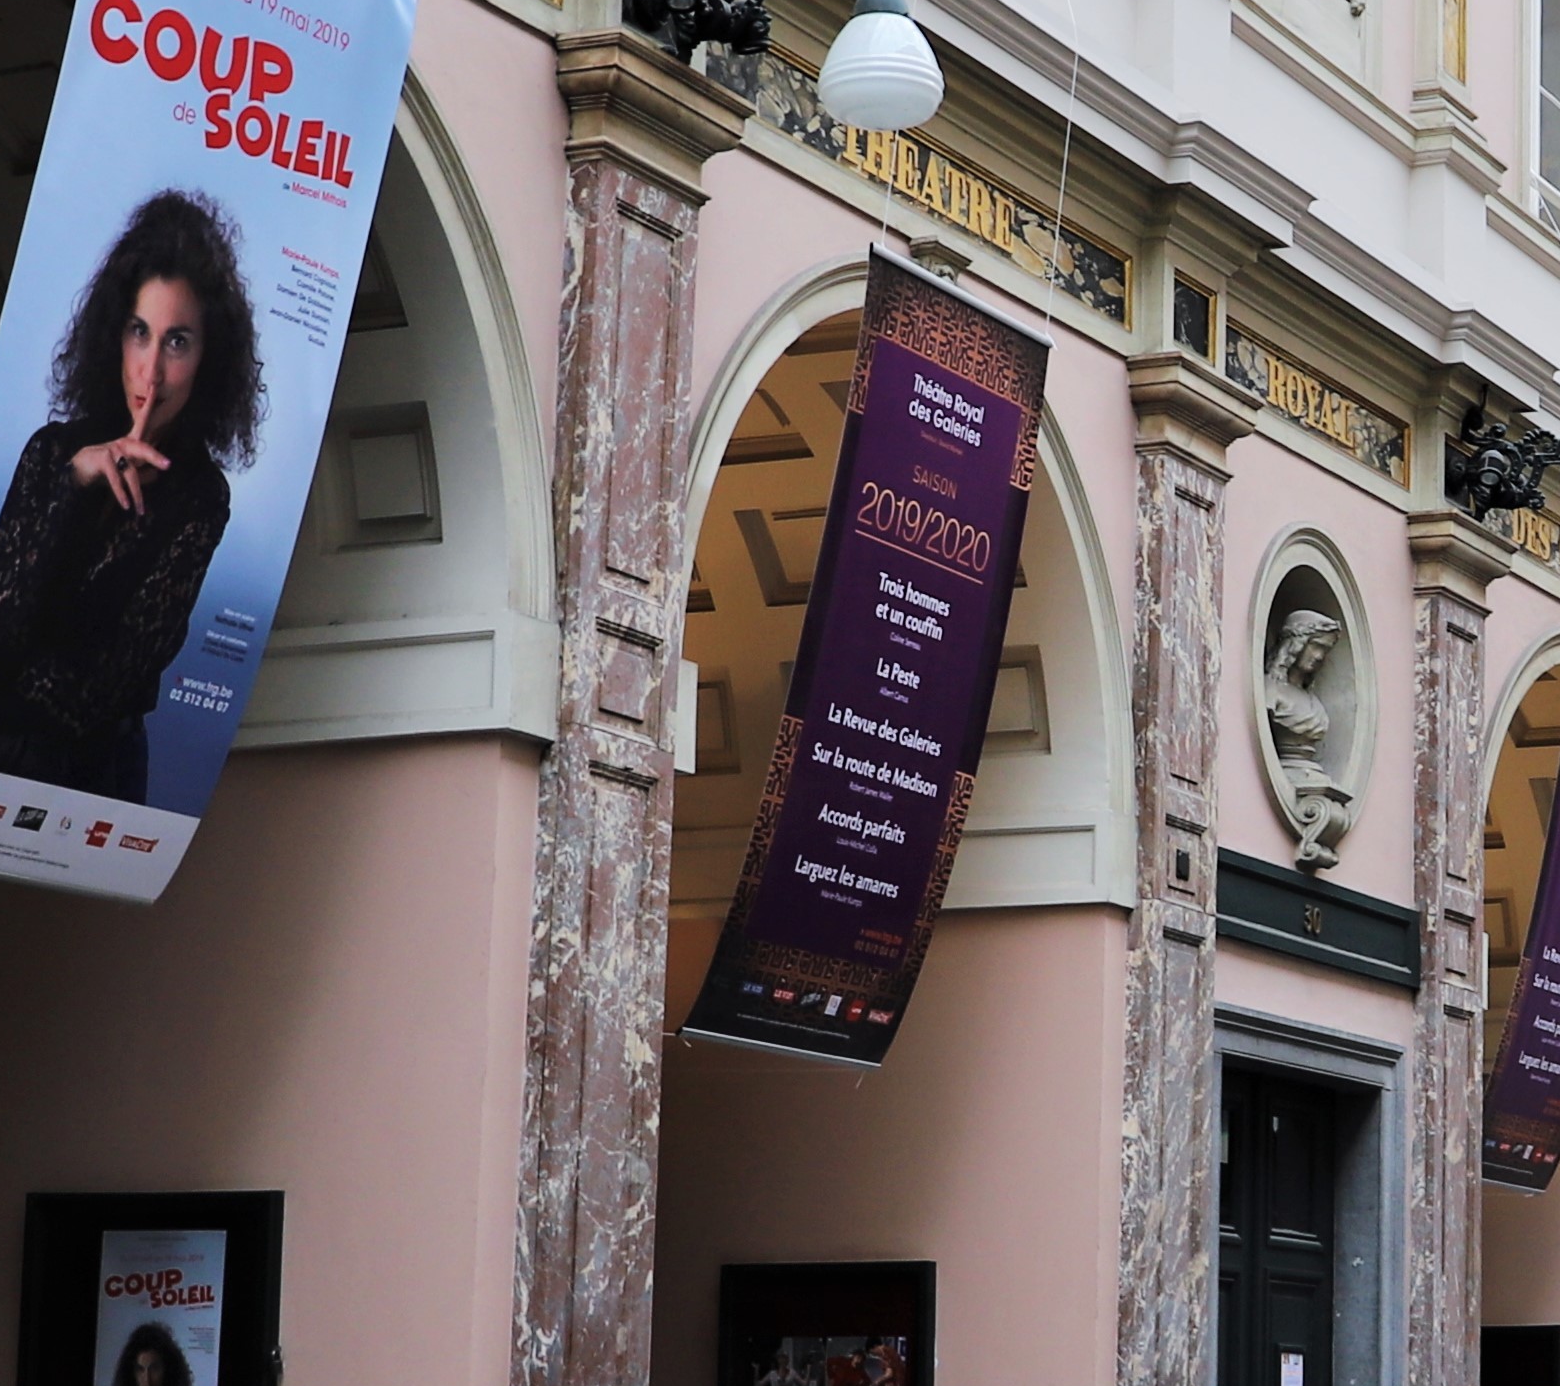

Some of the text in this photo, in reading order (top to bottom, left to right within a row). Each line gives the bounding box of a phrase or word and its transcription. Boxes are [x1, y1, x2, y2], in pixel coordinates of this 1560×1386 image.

[281, 6, 310, 33] mai
[313, 19, 350, 51] 2019
[173, 93, 353, 188] de SOLEIL
[842, 124, 1016, 253] THEATRE
[913, 373, 985, 424] Théâtre Royal
[1264, 356, 1355, 450] ROYAL
[909, 398, 931, 423] des
[933, 409, 981, 447] Galeries
[913, 465, 958, 500] SAISON
[857, 482, 990, 572] 2019/2020
[1512, 507, 1552, 561] DES
[879, 572, 951, 617] Trois hommes
[875, 602, 943, 641] et un couffin
[877, 657, 921, 690] La Peste
[170, 688, 183, 701] 02
[183, 692, 202, 706] 512
[828, 702, 942, 757] La Revue des Galeries
[812, 742, 938, 798] Sur la route de Madison
[818, 803, 906, 845] Accords parfaits
[794, 854, 900, 899] Larguez les amarres
[104, 1268, 183, 1298] COUP
[150, 1285, 215, 1308] SOLEIL
